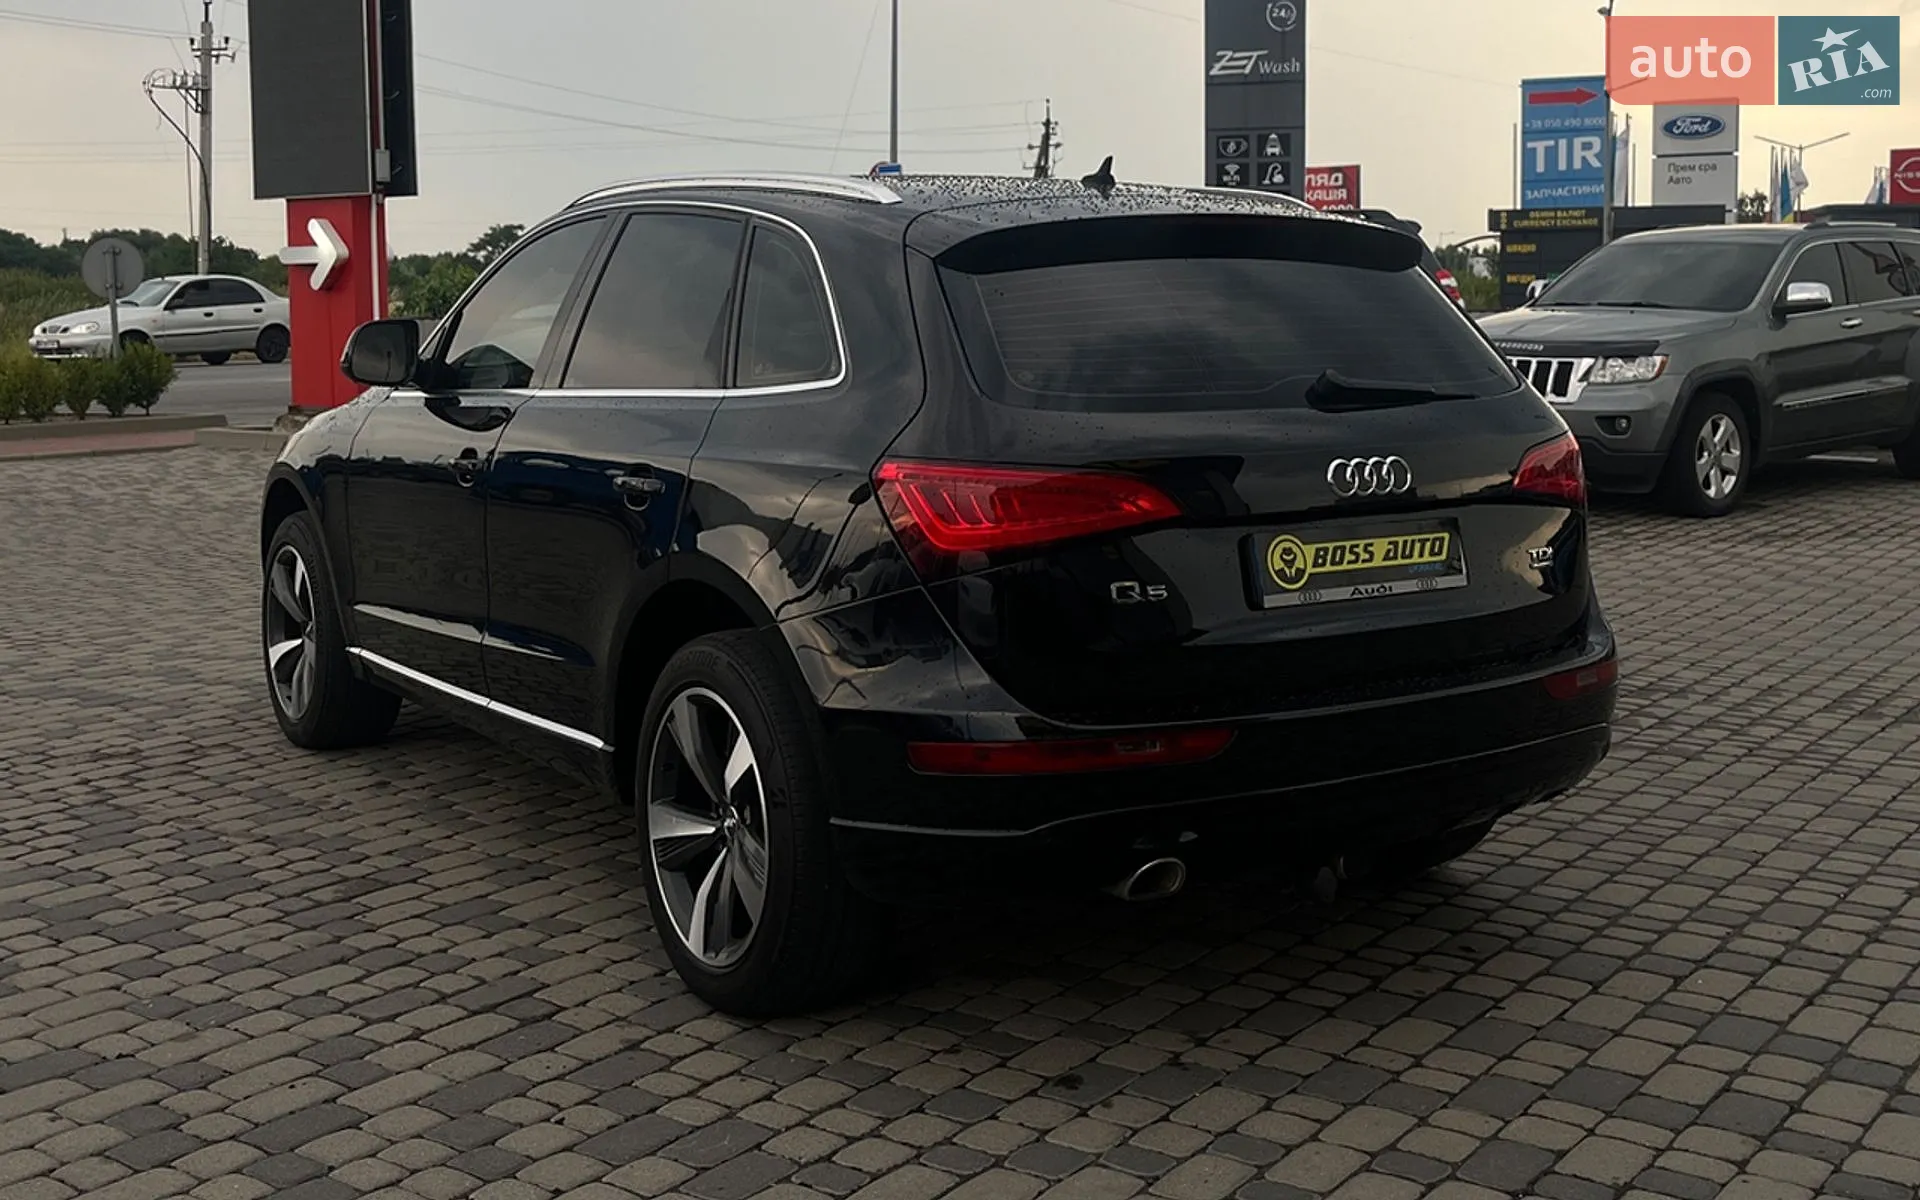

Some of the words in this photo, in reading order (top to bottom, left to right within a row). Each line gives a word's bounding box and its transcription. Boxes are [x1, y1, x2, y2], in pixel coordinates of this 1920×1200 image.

[1209, 50, 1268, 75] ZET
[1258, 57, 1300, 74] Wash
[1672, 117, 1712, 134] Ford
[1527, 136, 1602, 173] TIR
[1312, 541, 1375, 569] BOSS
[1382, 535, 1446, 562] AUTO
[1110, 581, 1168, 603] Q5
